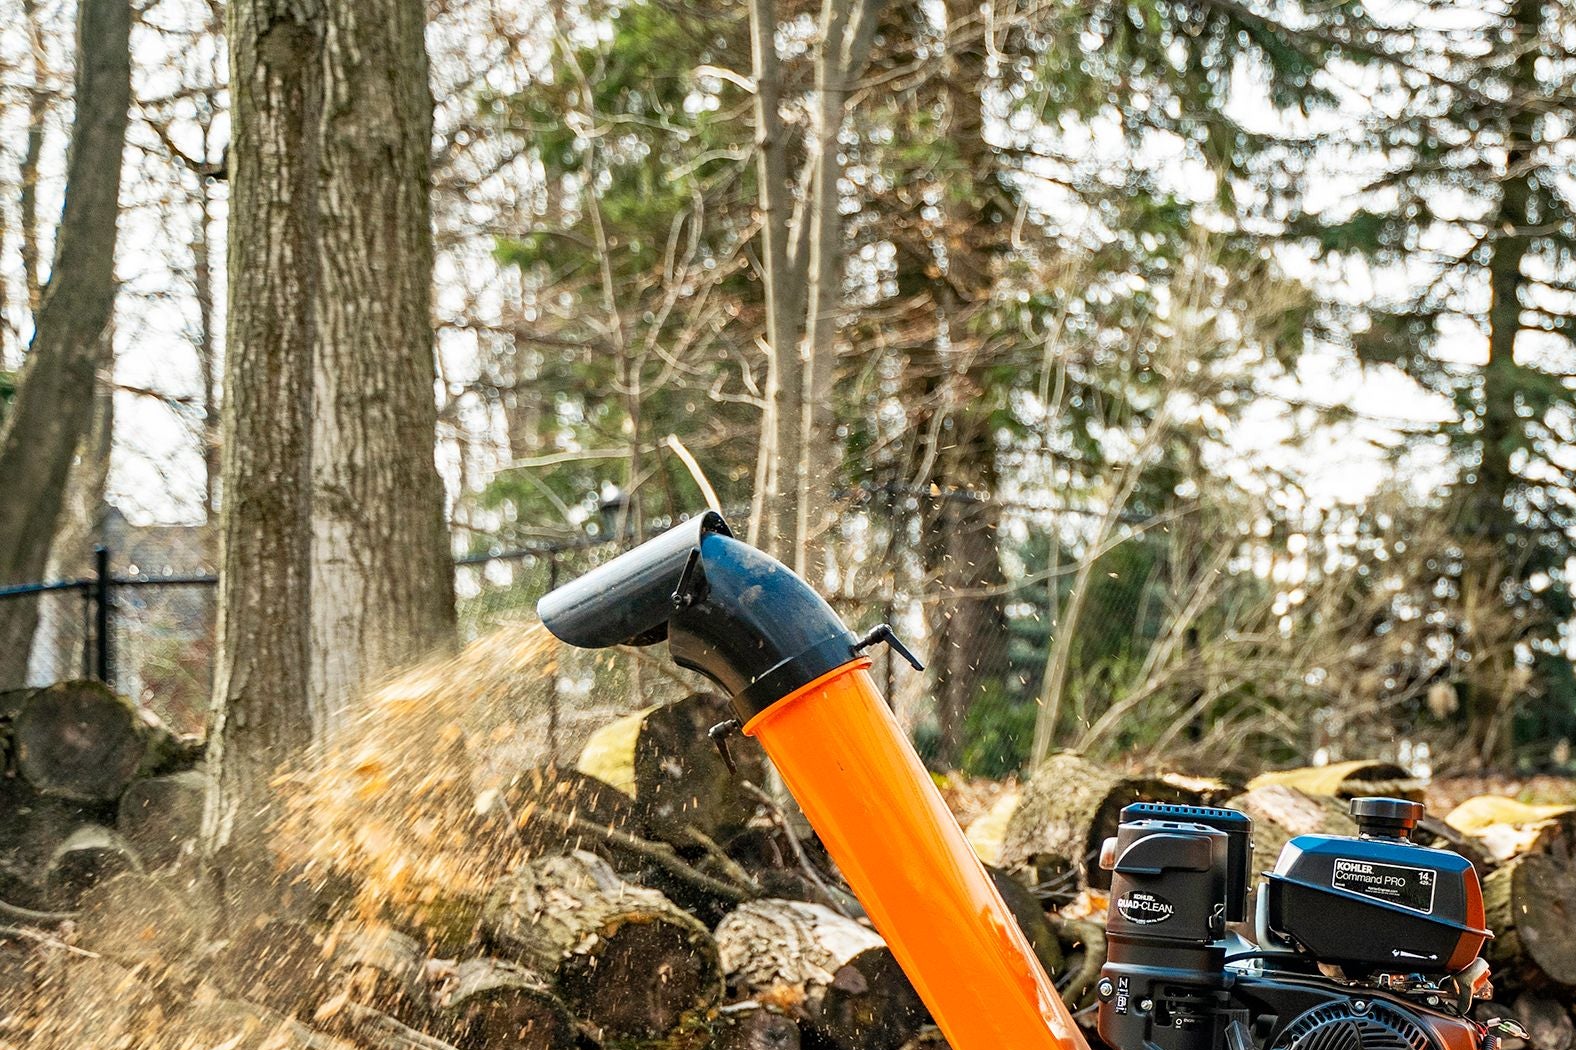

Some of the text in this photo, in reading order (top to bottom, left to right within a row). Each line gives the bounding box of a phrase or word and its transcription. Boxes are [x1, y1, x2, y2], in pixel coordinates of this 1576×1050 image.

[1335, 870, 1383, 885] Command
[1384, 875, 1406, 887] PRO
[1418, 871, 1429, 881] 14
